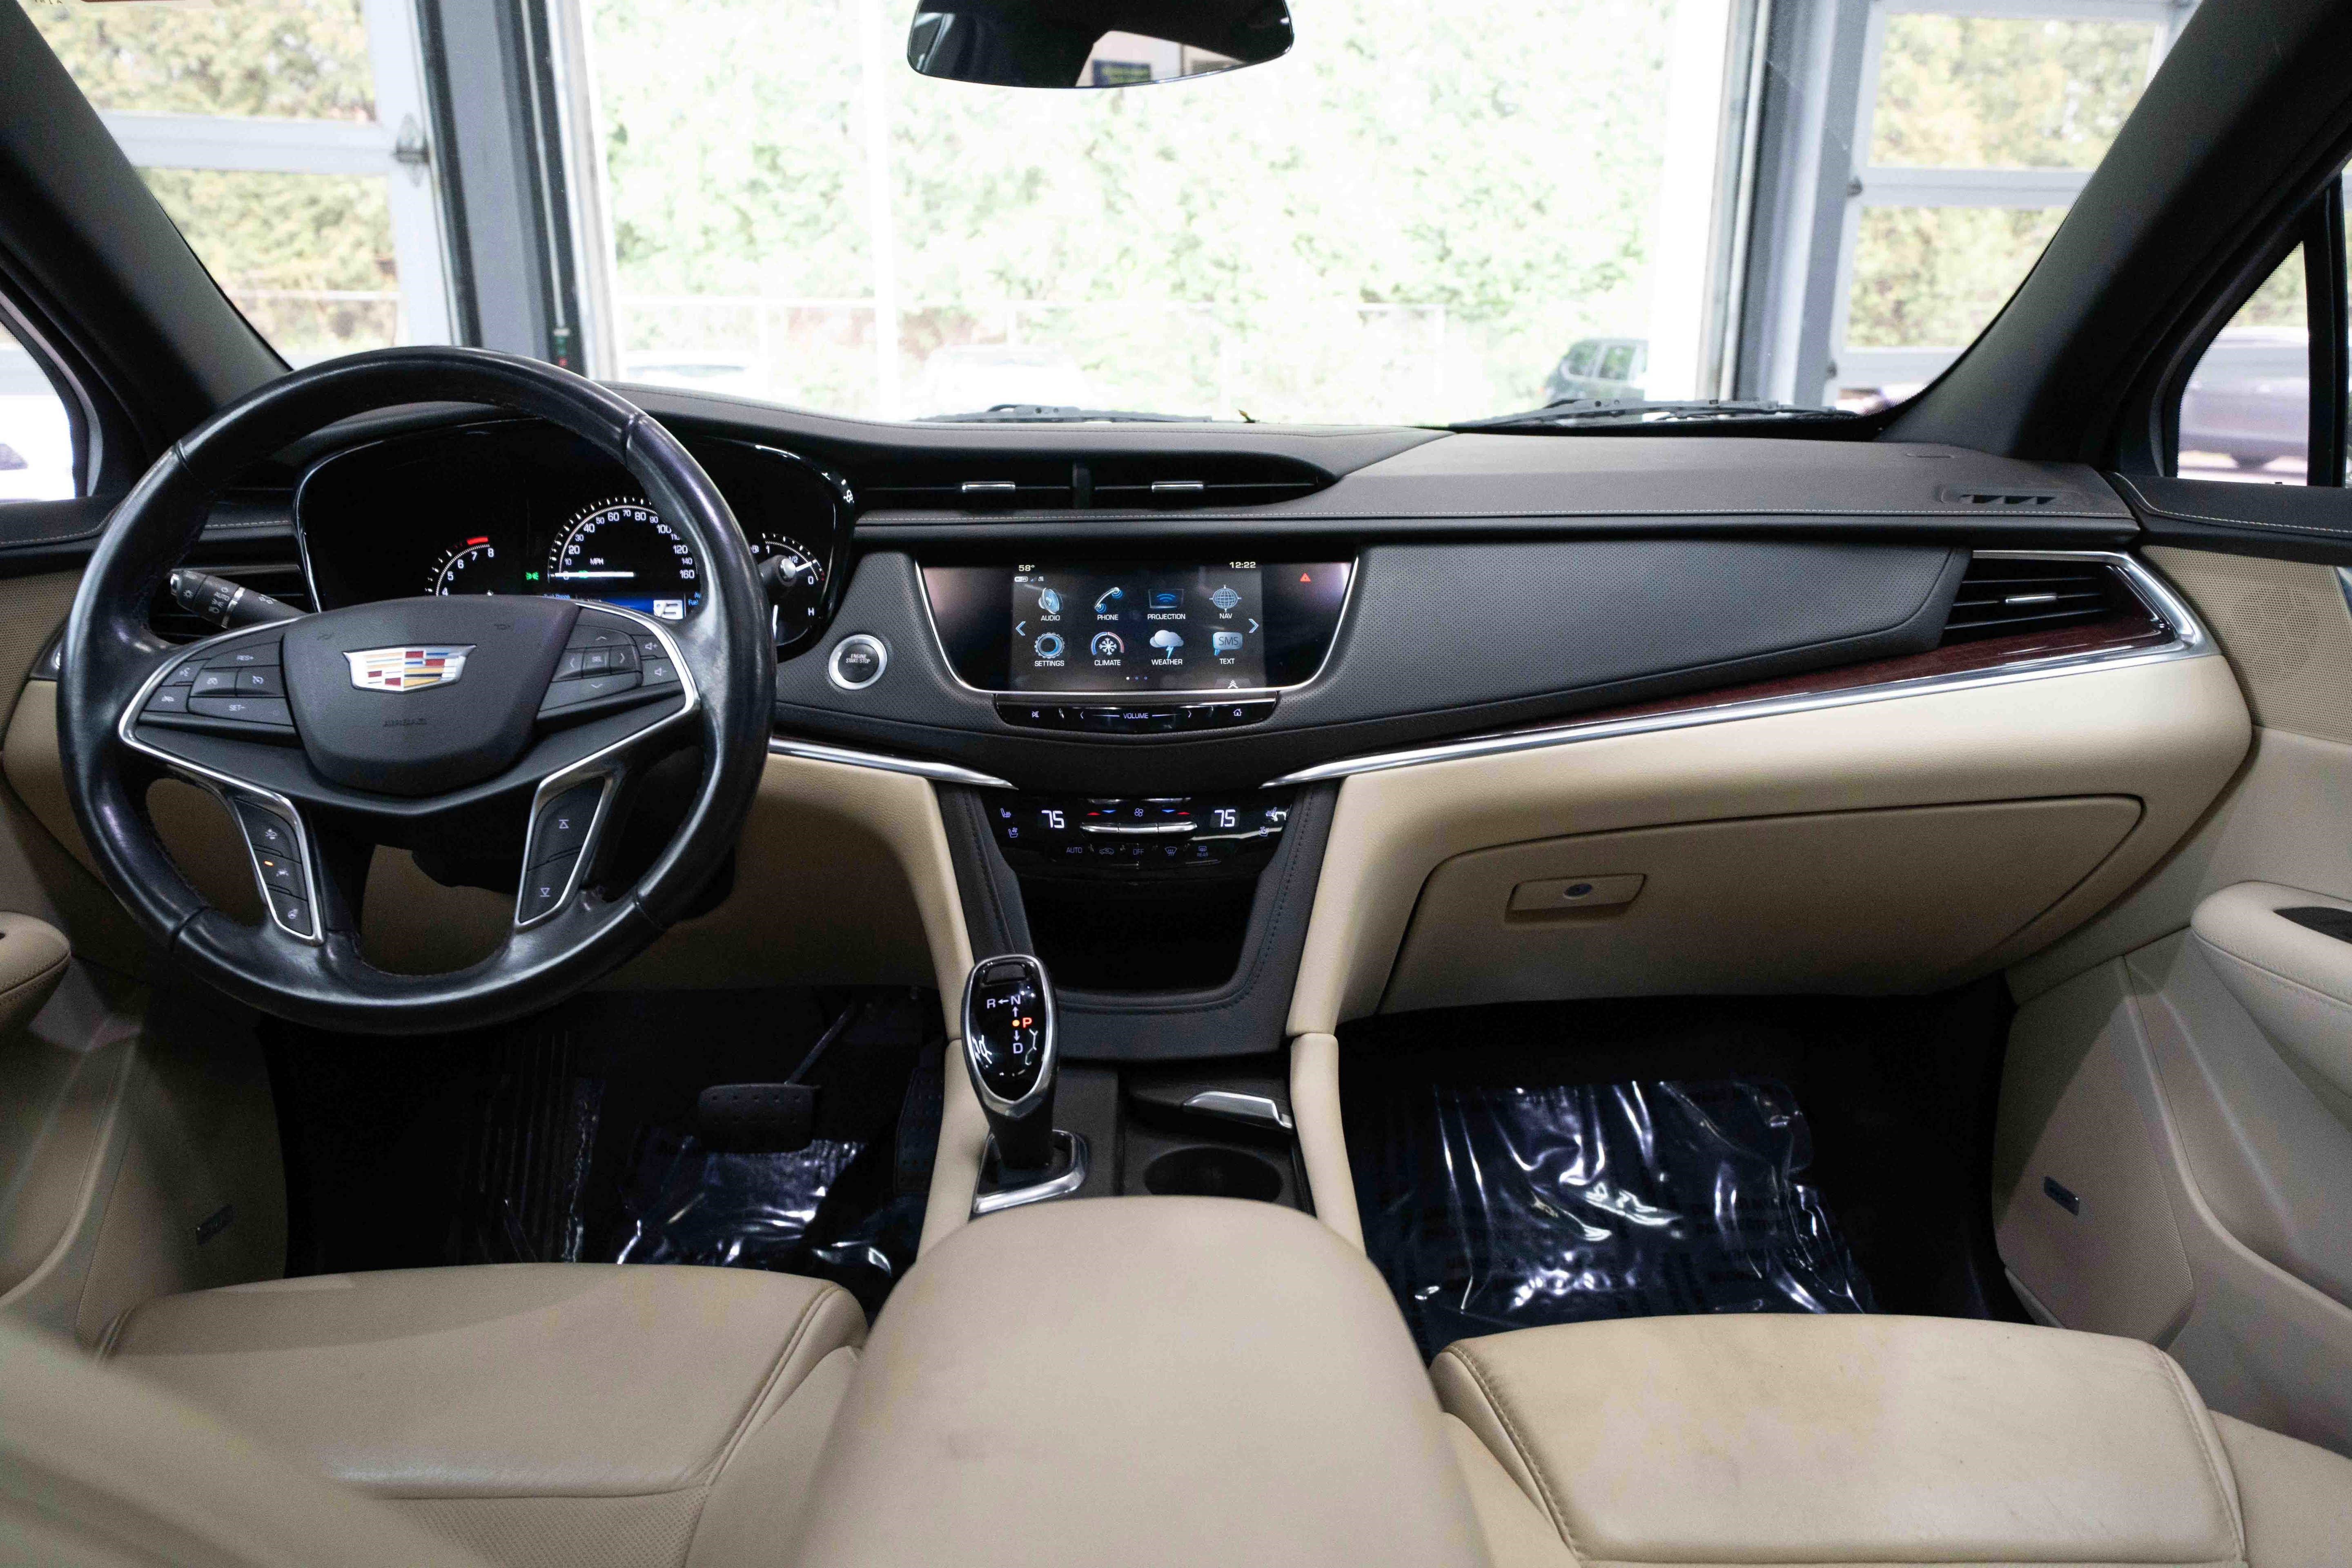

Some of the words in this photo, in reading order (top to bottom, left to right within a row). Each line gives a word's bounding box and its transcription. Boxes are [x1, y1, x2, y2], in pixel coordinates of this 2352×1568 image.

[608, 512, 619, 521] 60
[635, 512, 646, 521] 80
[584, 523, 595, 532] 40
[657, 524, 672, 533] 100
[488, 548, 494, 558] 8
[568, 545, 580, 554] 20
[673, 545, 688, 554] 120
[766, 545, 770, 554] 1
[471, 552, 477, 561] 7
[457, 559, 464, 569] 6
[447, 571, 454, 581] 5
[680, 570, 695, 579] 160
[442, 587, 448, 596] 4
[808, 607, 814, 616] H
[1218, 636, 1239, 646] SMS
[1041, 810, 1065, 828] 75
[1214, 809, 1236, 827] 75
[987, 998, 996, 1009] R
[1011, 995, 1021, 1005] N
[1022, 1017, 1032, 1028] P
[1013, 1042, 1023, 1054] D
